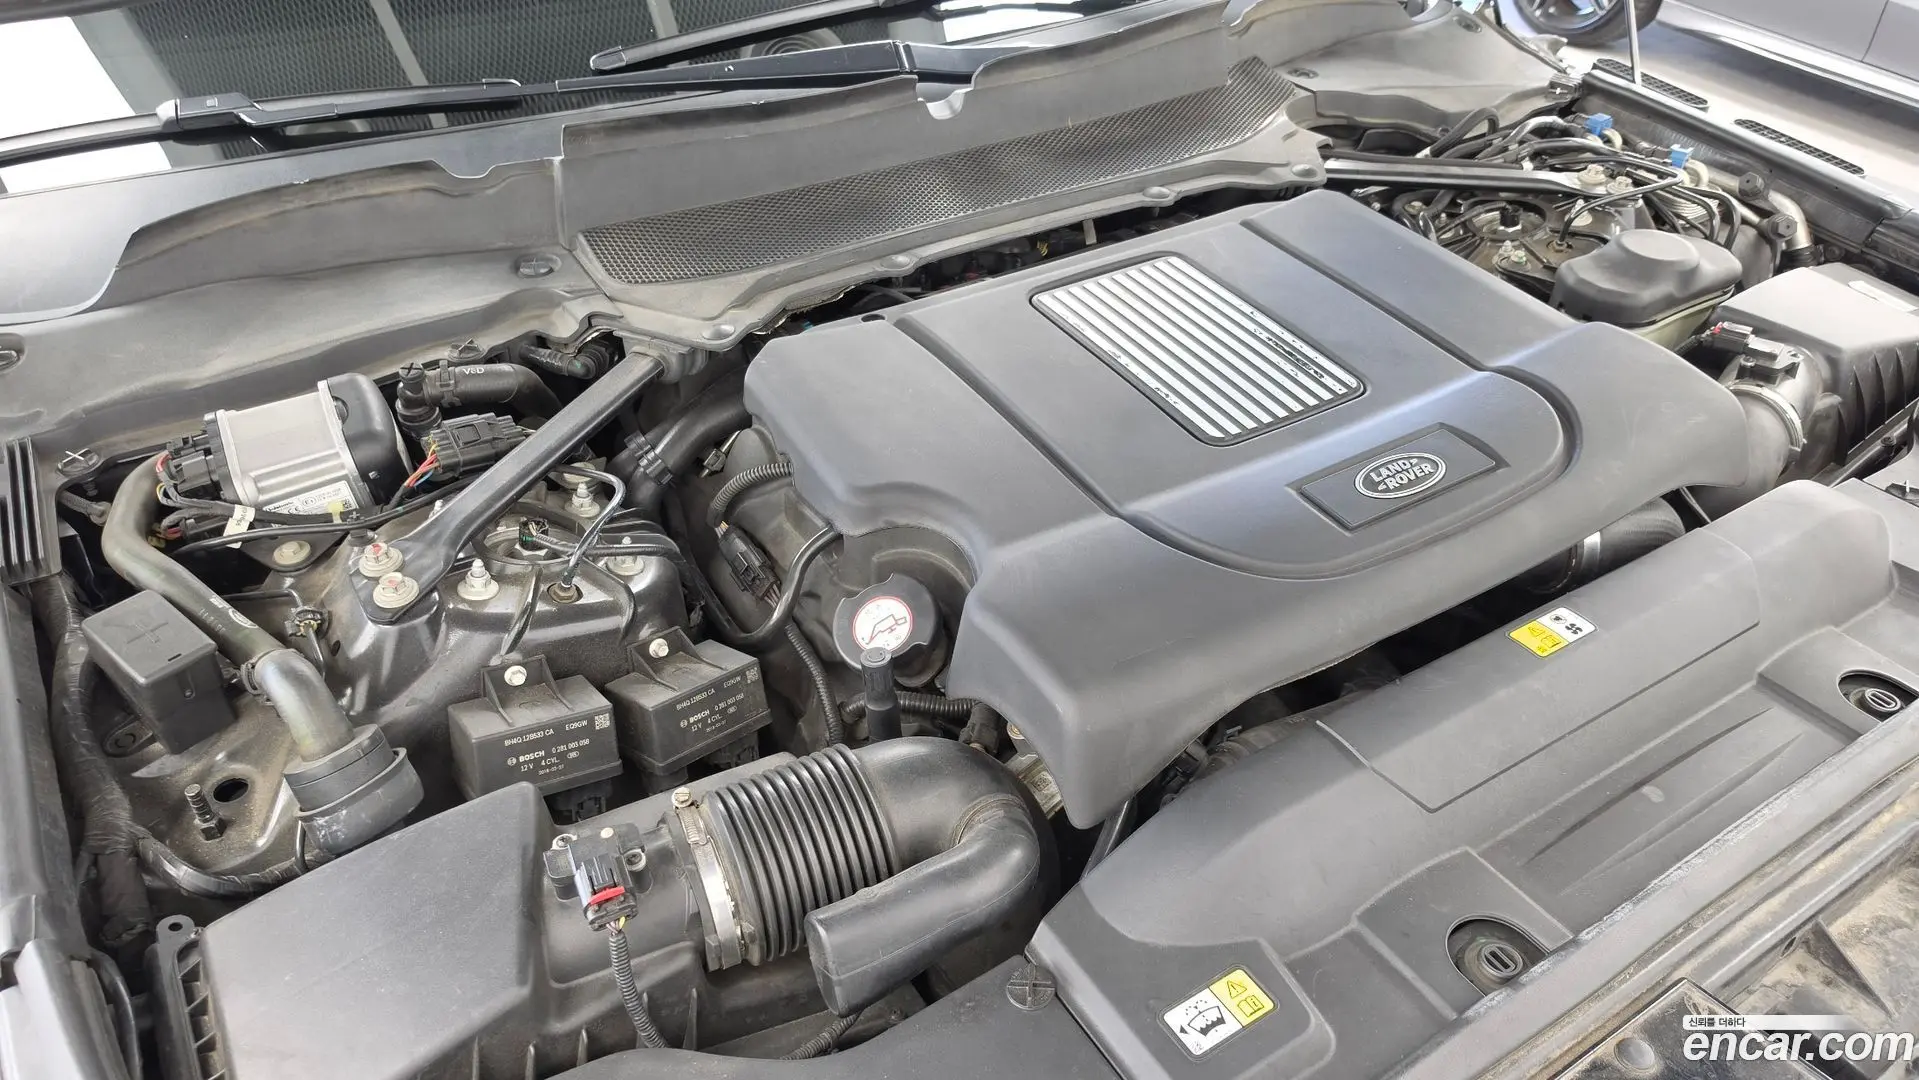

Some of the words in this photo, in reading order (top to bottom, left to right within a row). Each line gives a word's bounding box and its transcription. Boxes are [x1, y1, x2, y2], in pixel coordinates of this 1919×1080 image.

[1369, 459, 1412, 482] LAND
[1384, 463, 1436, 490] ROVER
[689, 709, 711, 723] BOSCH
[545, 728, 555, 736] CA
[691, 724, 698, 732] 12
[519, 750, 545, 762] BOSCH
[557, 744, 567, 753] 281
[568, 741, 579, 750] 003
[579, 738, 590, 747] 058
[520, 764, 528, 772] 12
